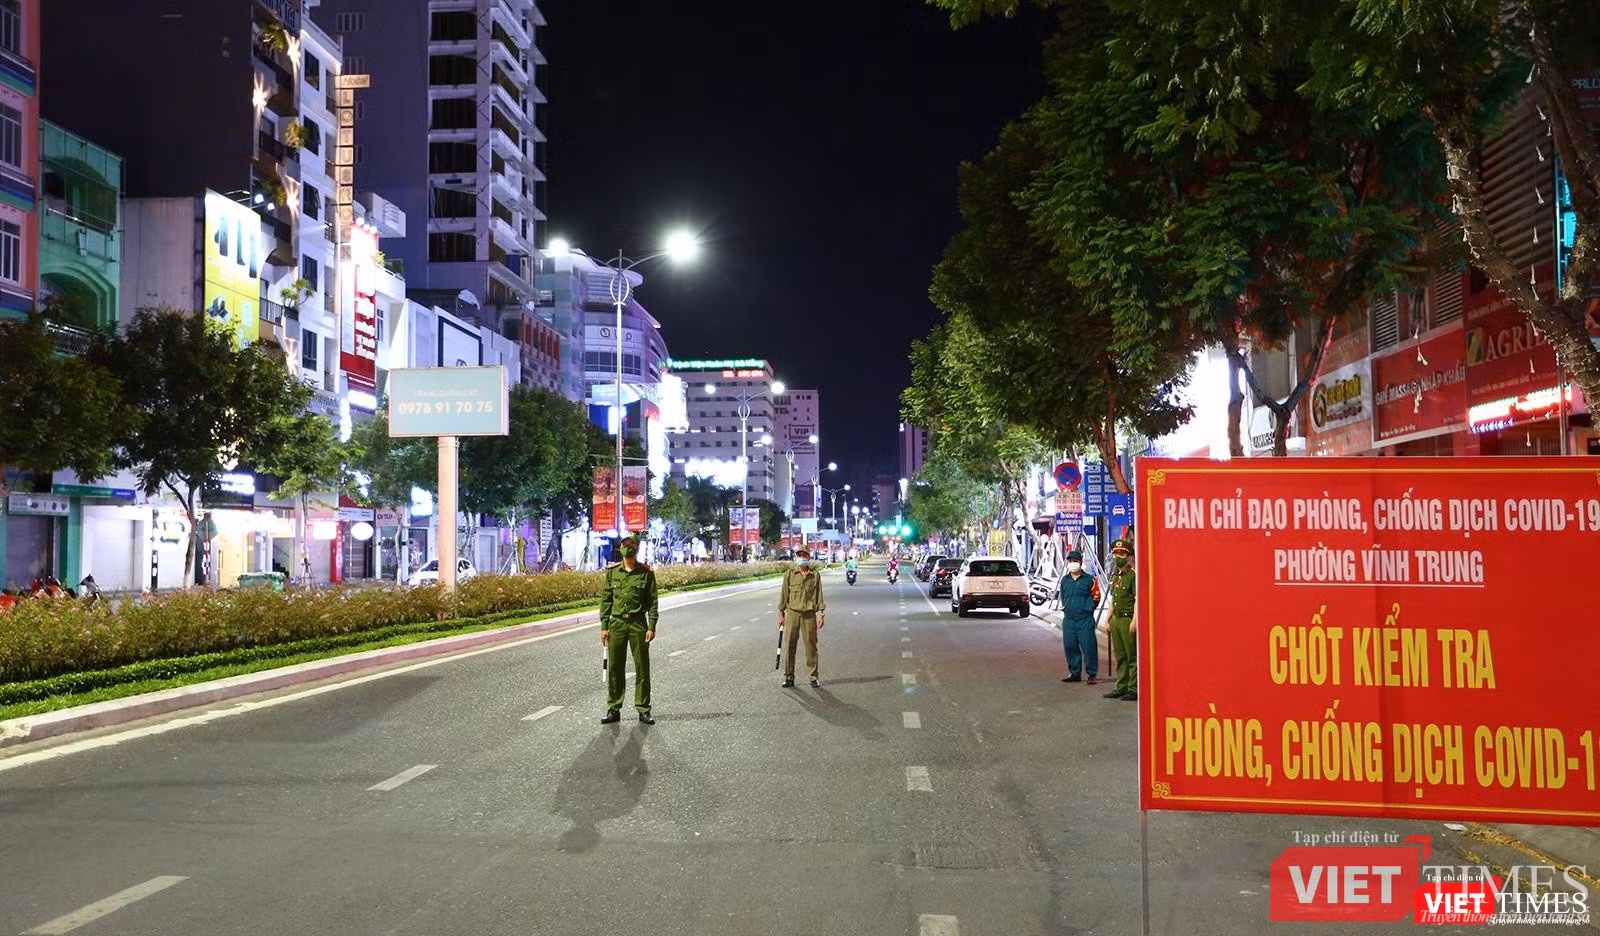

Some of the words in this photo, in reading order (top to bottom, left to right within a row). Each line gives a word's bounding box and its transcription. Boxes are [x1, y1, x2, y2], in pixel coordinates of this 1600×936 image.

[399, 402, 431, 414] 0978
[435, 402, 450, 414] 91
[456, 401, 472, 413] 70
[476, 400, 493, 413] 75
[1164, 498, 1205, 529] BAN
[1210, 488, 1243, 530] CHỈ
[1248, 498, 1288, 536] ĐẠO
[1293, 491, 1367, 534] PHÒNG,
[1373, 488, 1443, 531] CHỐNG
[1449, 499, 1498, 538] DỊCH
[1504, 499, 1600, 532] COVID-19
[1274, 542, 1356, 581] PHƯỜNG
[1361, 543, 1410, 582] VĨNH
[1415, 550, 1483, 583] TRUNG
[1269, 605, 1343, 686] CHỐT
[1352, 602, 1429, 688] KIỂM
[1437, 628, 1496, 689] TRA
[1165, 703, 1272, 787] PHÒNG,
[1282, 699, 1383, 783] CHỐNG
[1392, 723, 1465, 798] DỊCH
[1474, 724, 1600, 791] COVID-1
